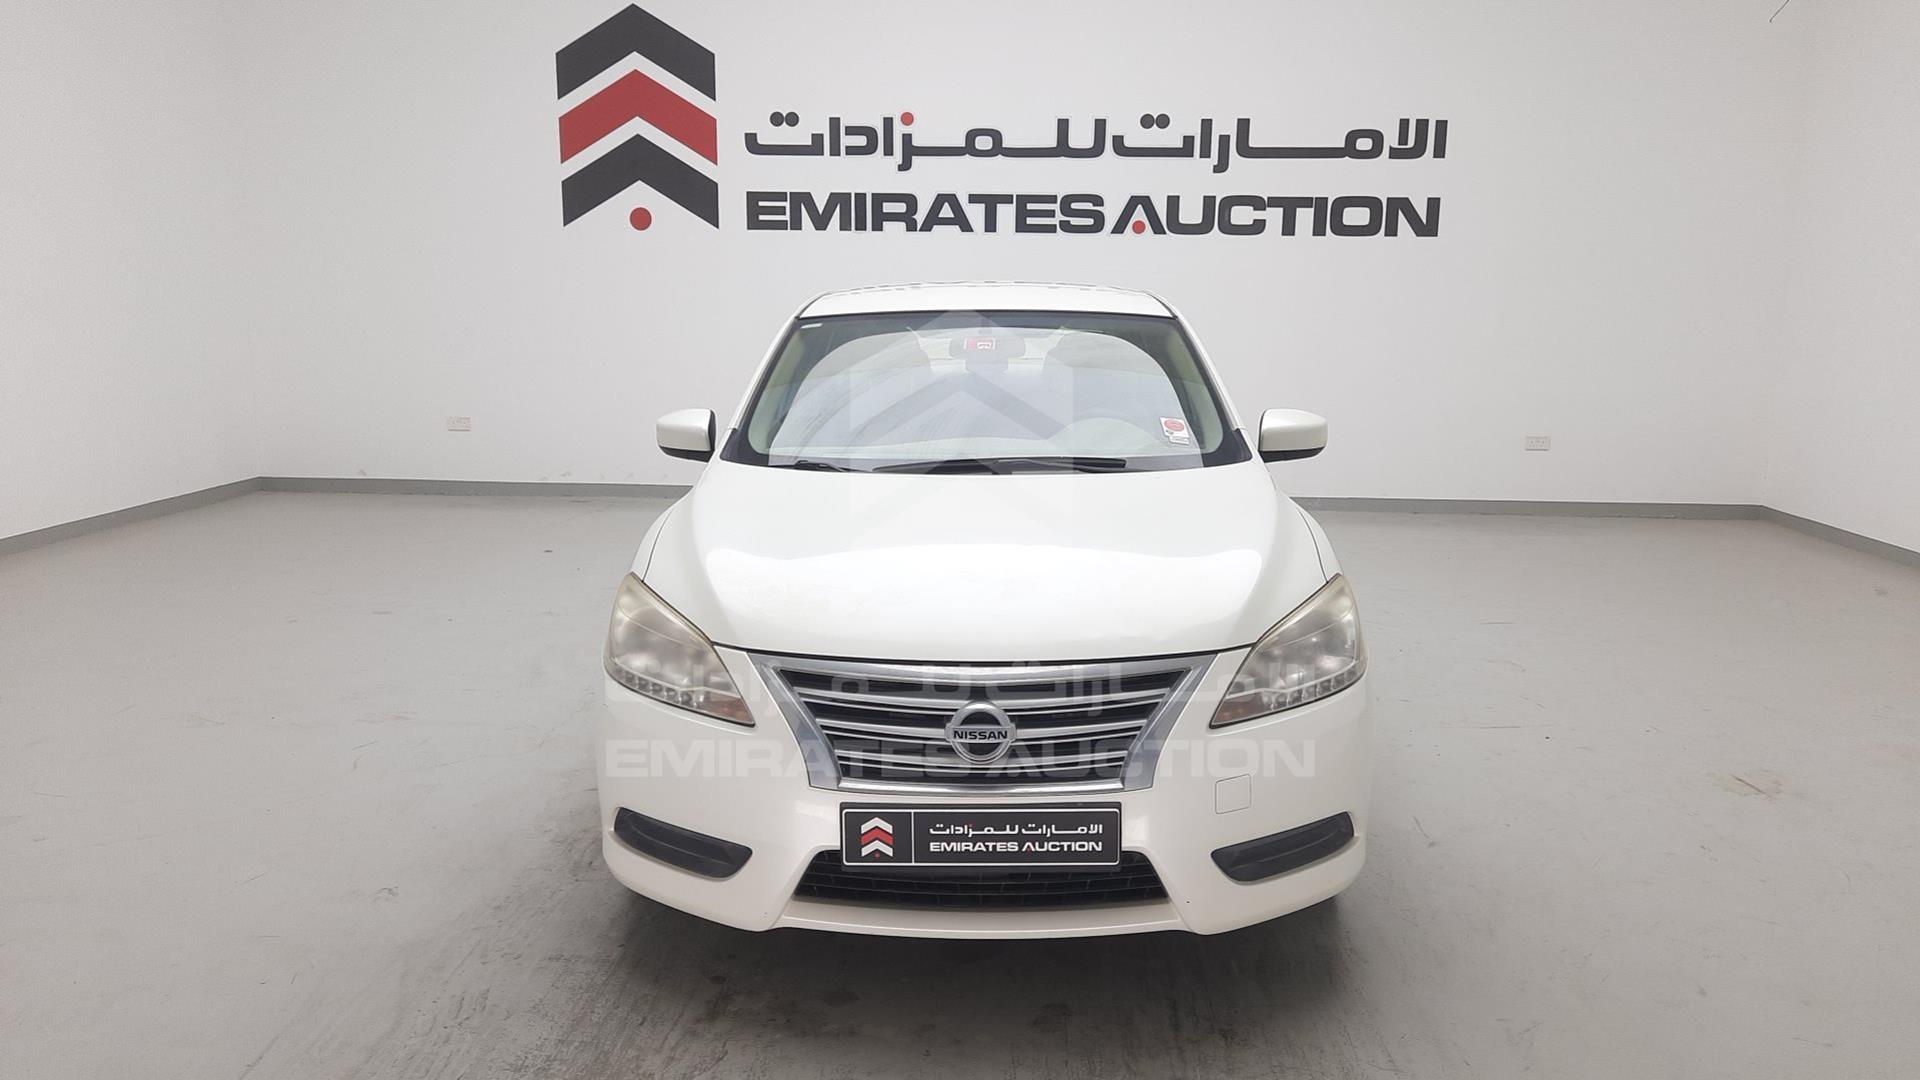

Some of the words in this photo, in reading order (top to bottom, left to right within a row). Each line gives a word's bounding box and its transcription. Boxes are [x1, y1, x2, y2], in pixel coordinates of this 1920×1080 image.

[746, 190, 1106, 234] EMIRATES
[1110, 194, 1441, 238] AUCTION
[953, 729, 1008, 740] NISSAN
[929, 841, 1019, 852] EMIRATES
[1021, 841, 1103, 852] AUCTION
